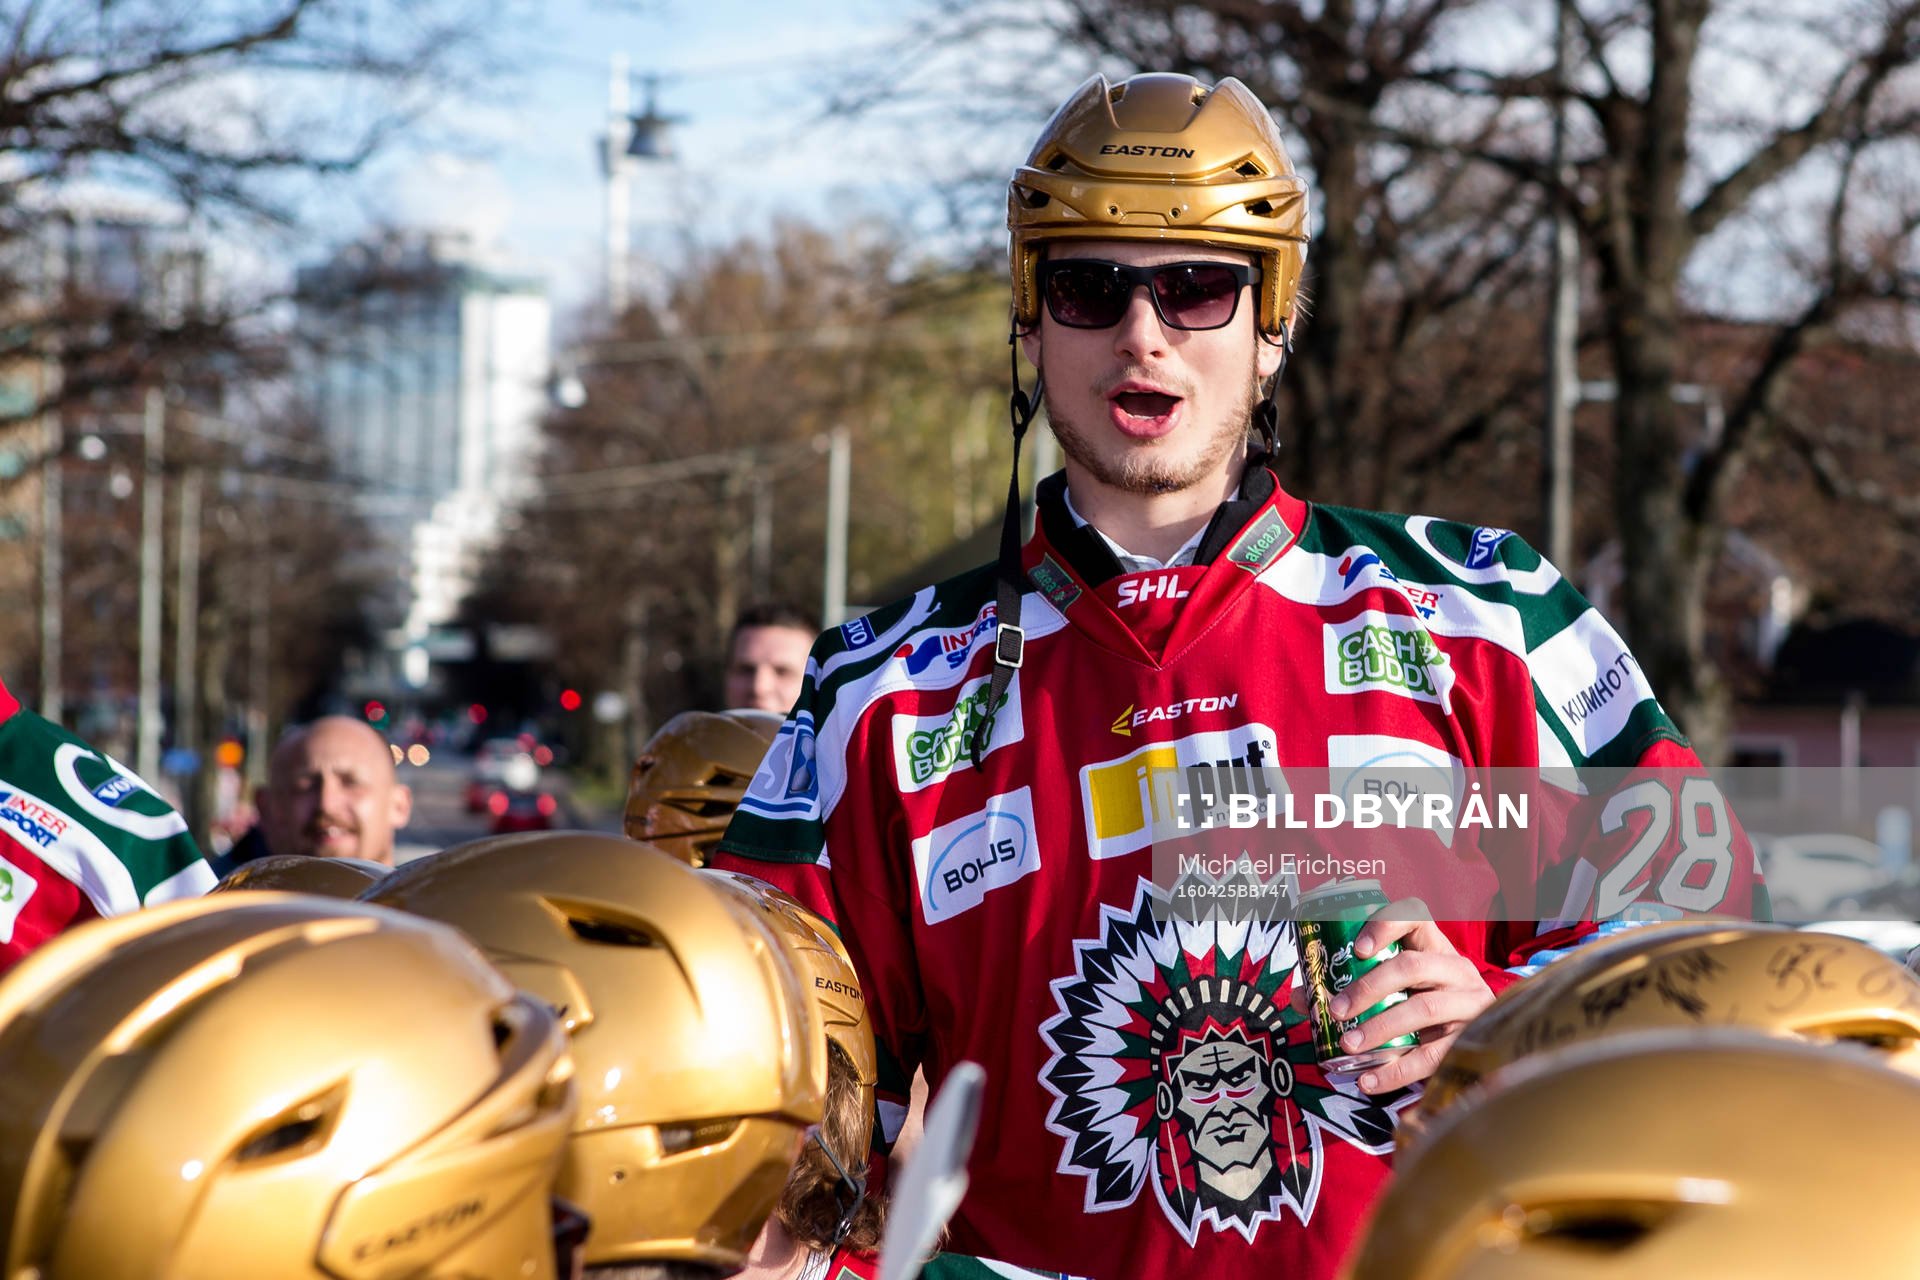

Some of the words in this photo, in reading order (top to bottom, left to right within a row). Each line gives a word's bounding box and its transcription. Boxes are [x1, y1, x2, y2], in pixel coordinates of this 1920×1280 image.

[1099, 144, 1195, 158] EASTON
[1245, 530, 1277, 562] akea
[1117, 574, 1189, 608] SHL
[1343, 630, 1416, 661] CASH
[1133, 693, 1238, 727] EASTON
[1137, 740, 1272, 829] input
[7, 795, 68, 835] INTER
[1594, 777, 1735, 923] 28
[815, 976, 864, 1001] EASTON
